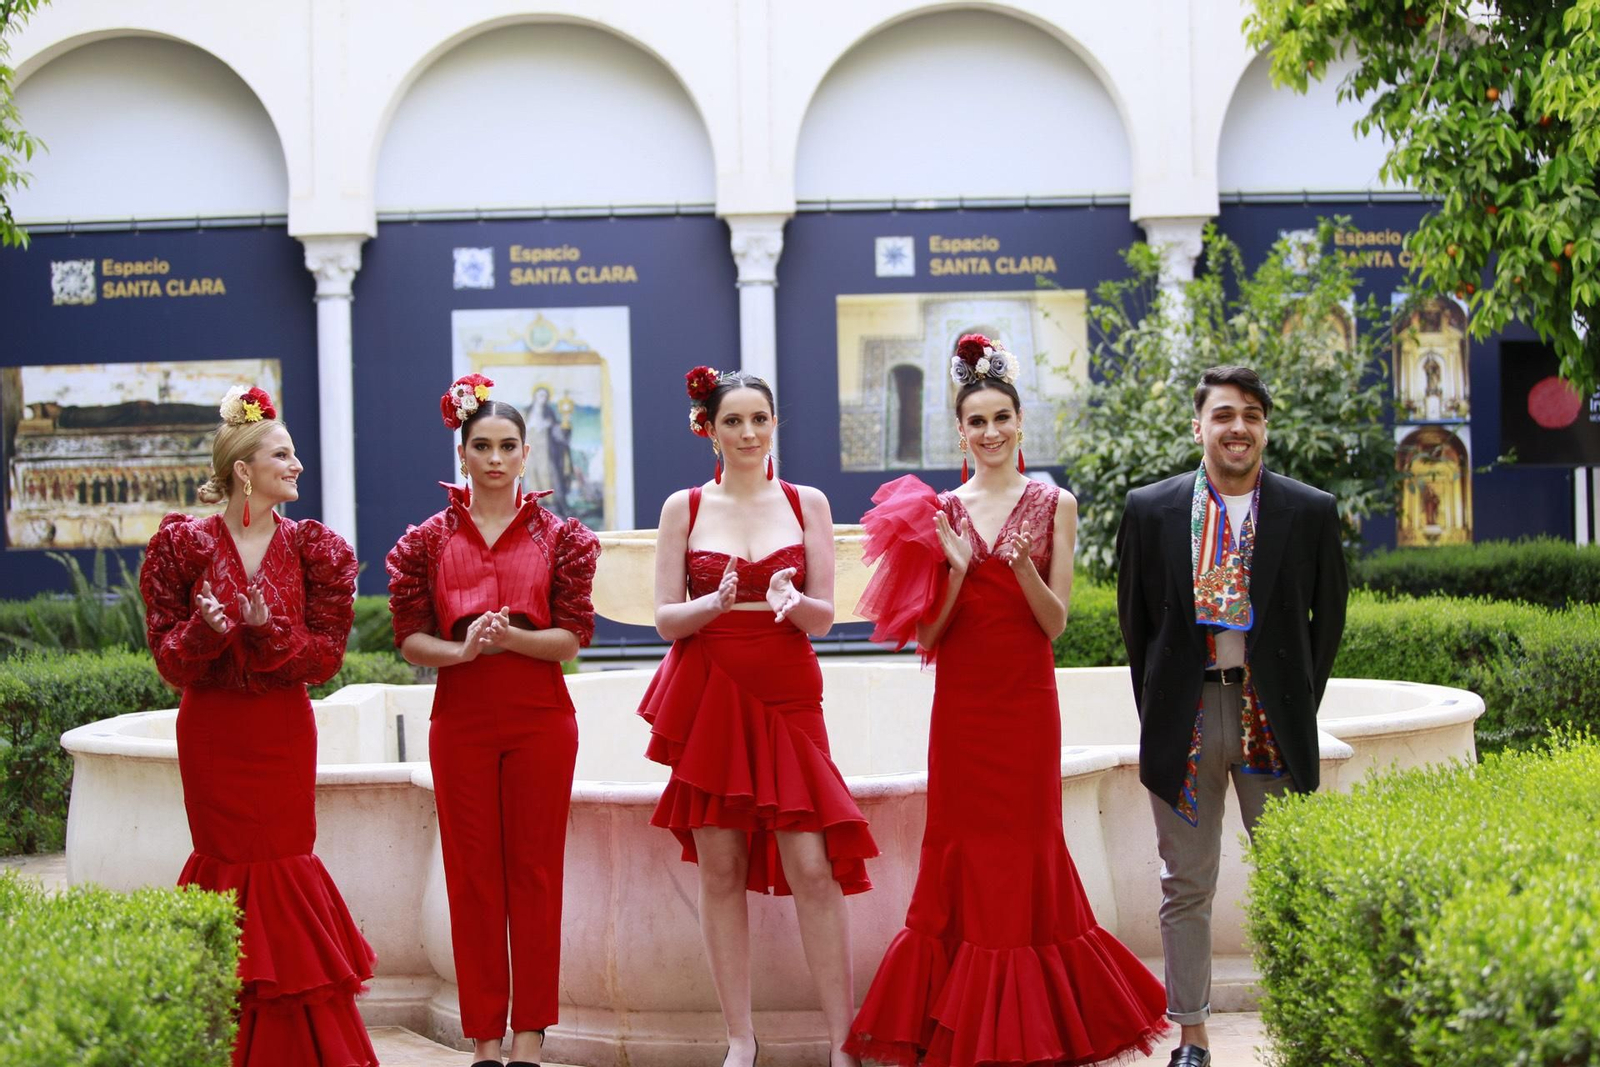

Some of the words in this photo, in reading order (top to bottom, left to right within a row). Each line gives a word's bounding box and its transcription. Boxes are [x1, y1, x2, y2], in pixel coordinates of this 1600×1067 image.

[929, 235, 1000, 255] Espacio
[1334, 228, 1401, 248] Espacio
[509, 244, 581, 265] Espacio
[102, 257, 170, 278] Espacio
[510, 267, 573, 286] SANTA
[575, 265, 638, 284] CLARA
[930, 256, 992, 276] SANTA
[995, 255, 1057, 275] CLARA
[102, 279, 163, 299] SANTA
[166, 277, 226, 297] CLARA
